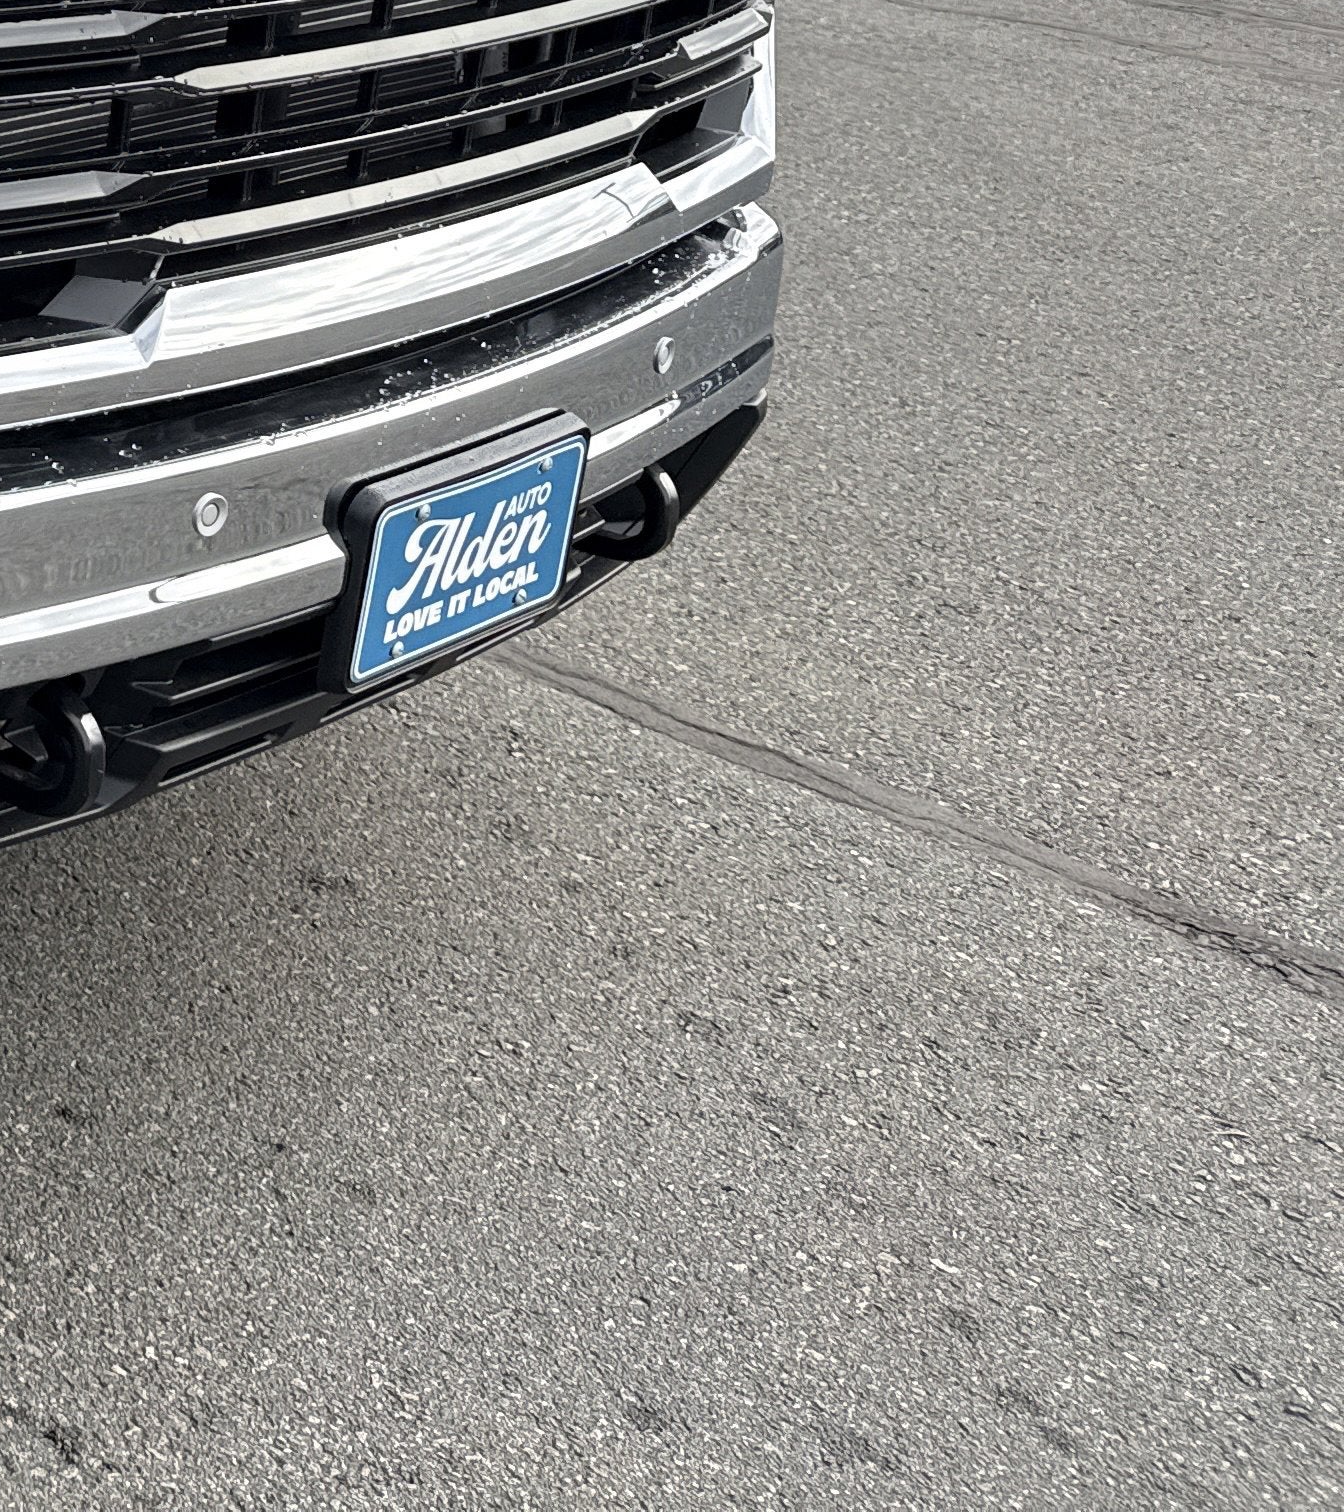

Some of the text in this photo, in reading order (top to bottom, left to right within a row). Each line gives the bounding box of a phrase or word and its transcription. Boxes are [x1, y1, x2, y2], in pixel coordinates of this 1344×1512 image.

[504, 482, 552, 520] AUTO
[386, 500, 552, 615] Alden
[383, 562, 539, 644] LOVE IT LOCAL
